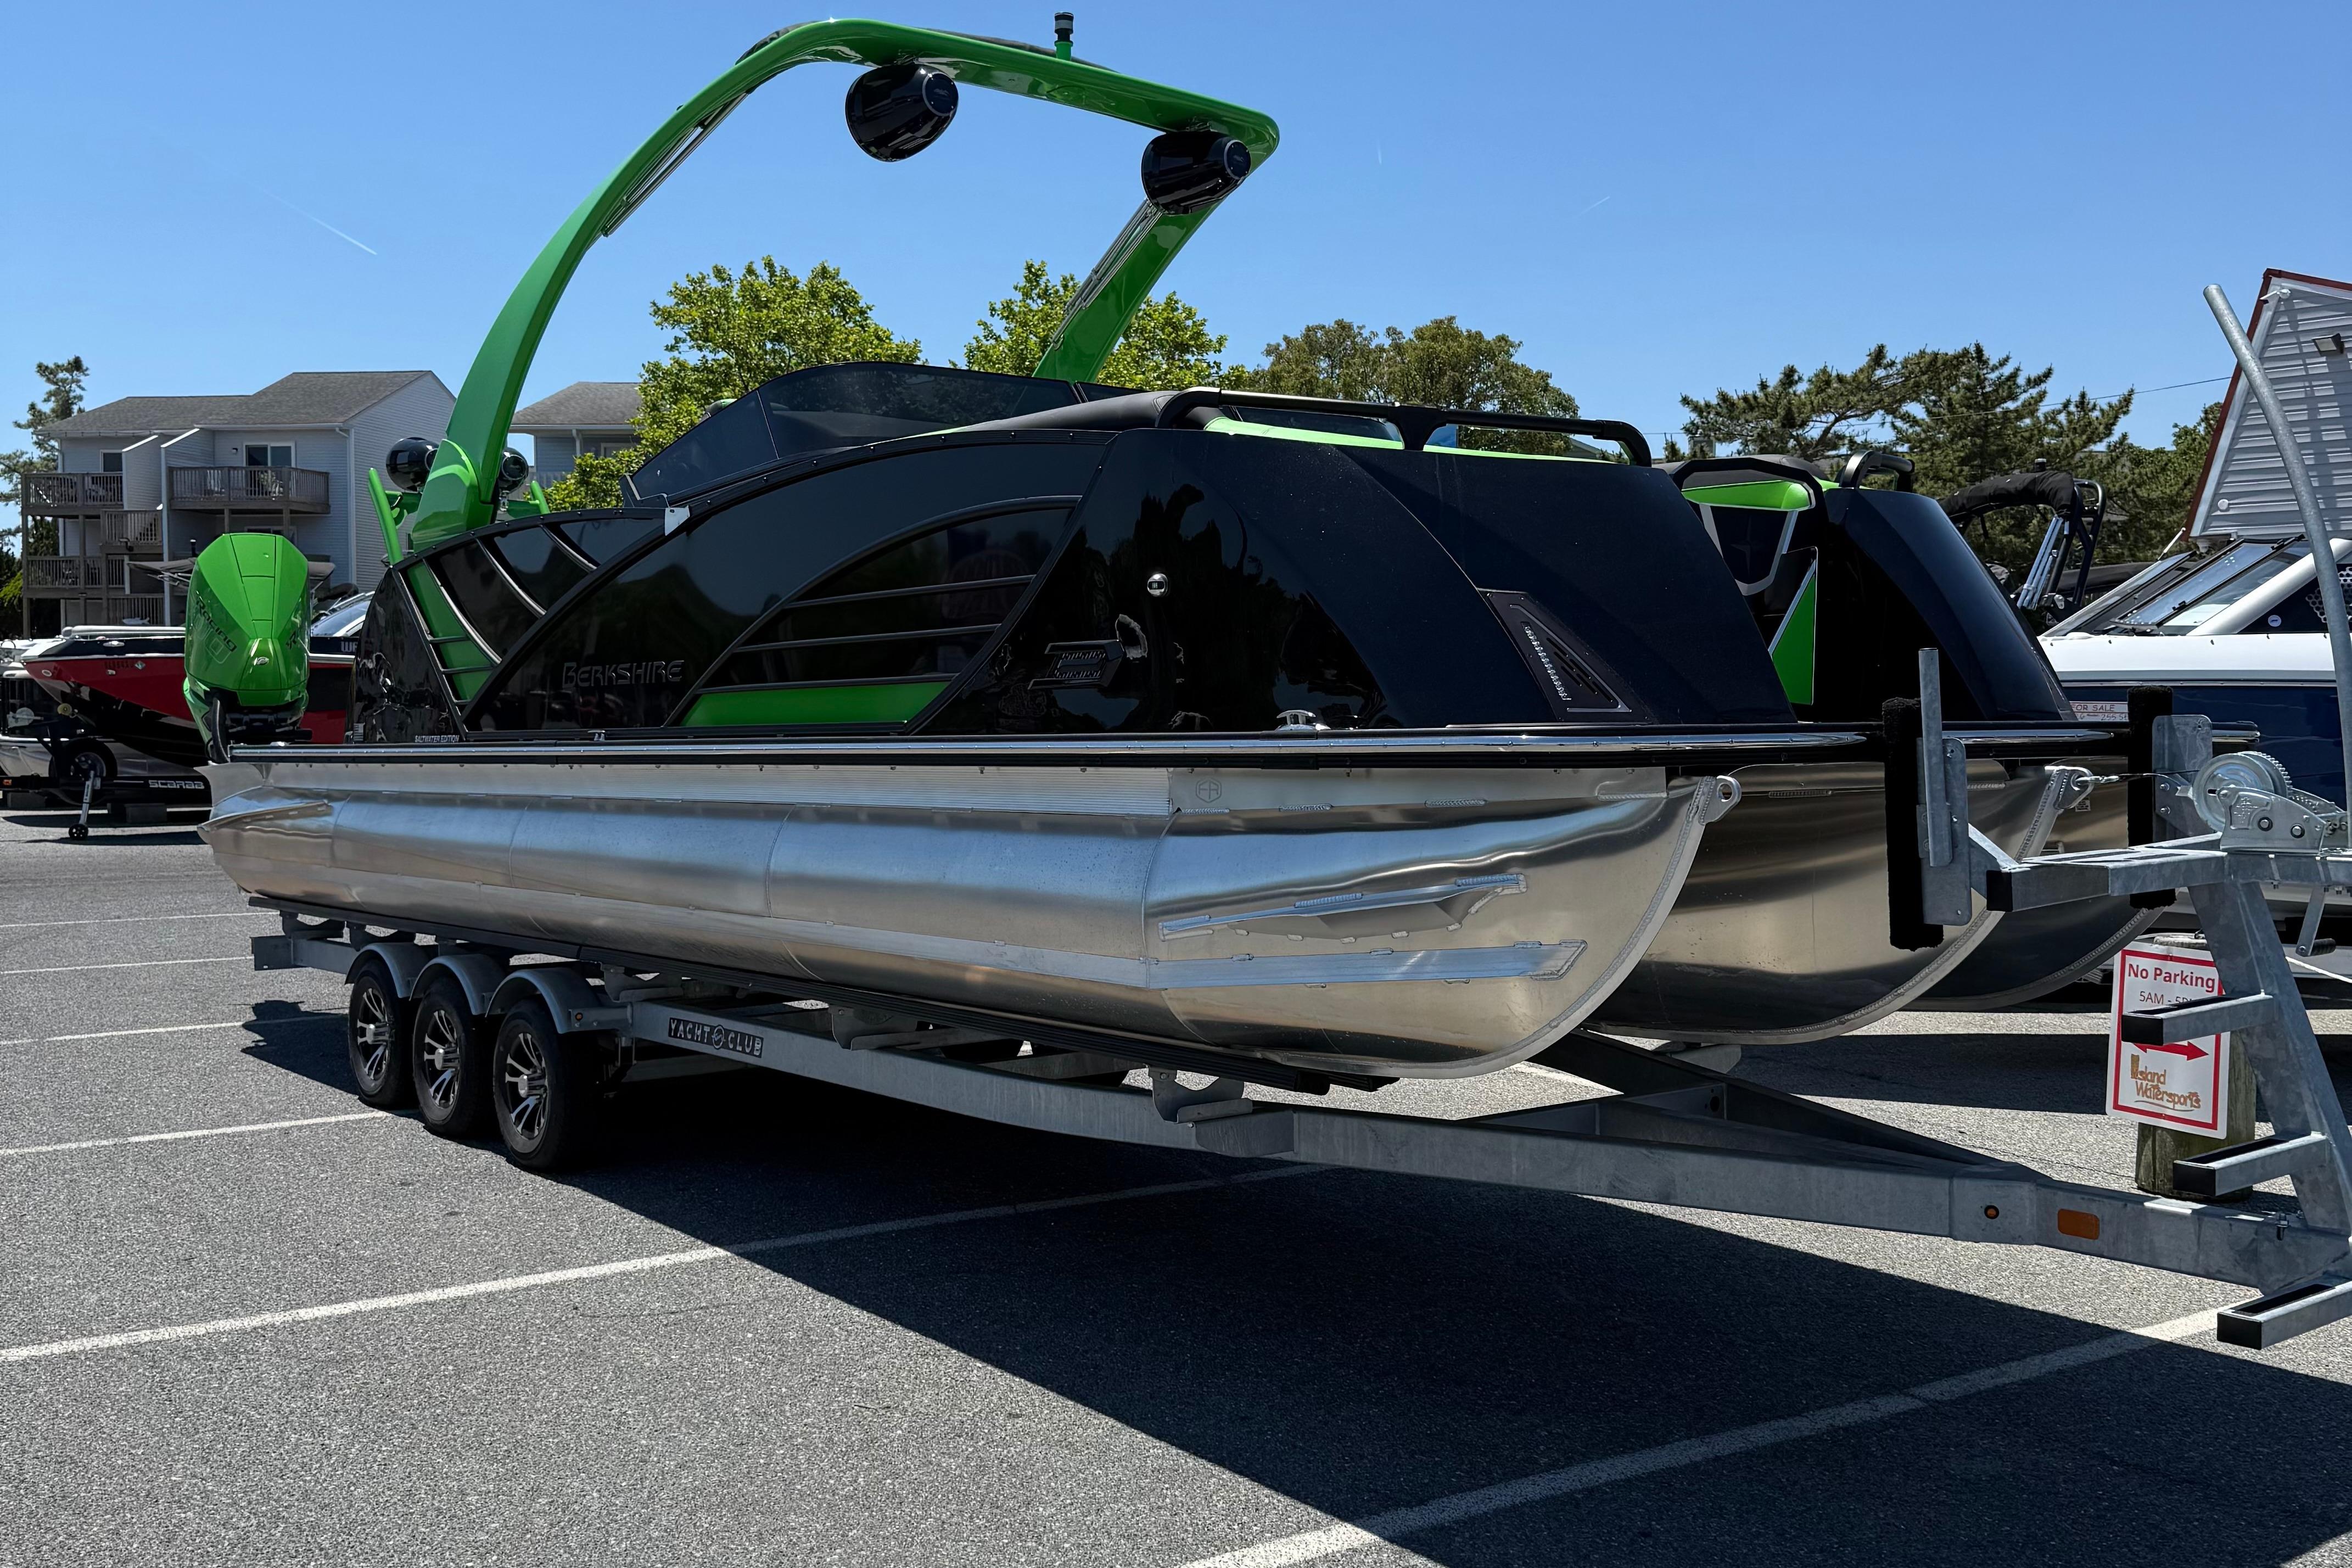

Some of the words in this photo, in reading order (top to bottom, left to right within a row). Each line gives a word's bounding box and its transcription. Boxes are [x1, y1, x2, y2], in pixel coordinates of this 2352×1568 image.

[440, 735, 459, 743] EDITION
[2128, 963, 2149, 979] No
[2153, 967, 2215, 993] Parking
[2139, 991, 2164, 1005] 5AM
[670, 1019, 710, 1043] YACHT
[728, 1032, 761, 1056] CLUB
[2131, 1054, 2166, 1085] Island
[2136, 1080, 2201, 1109] Watersports
